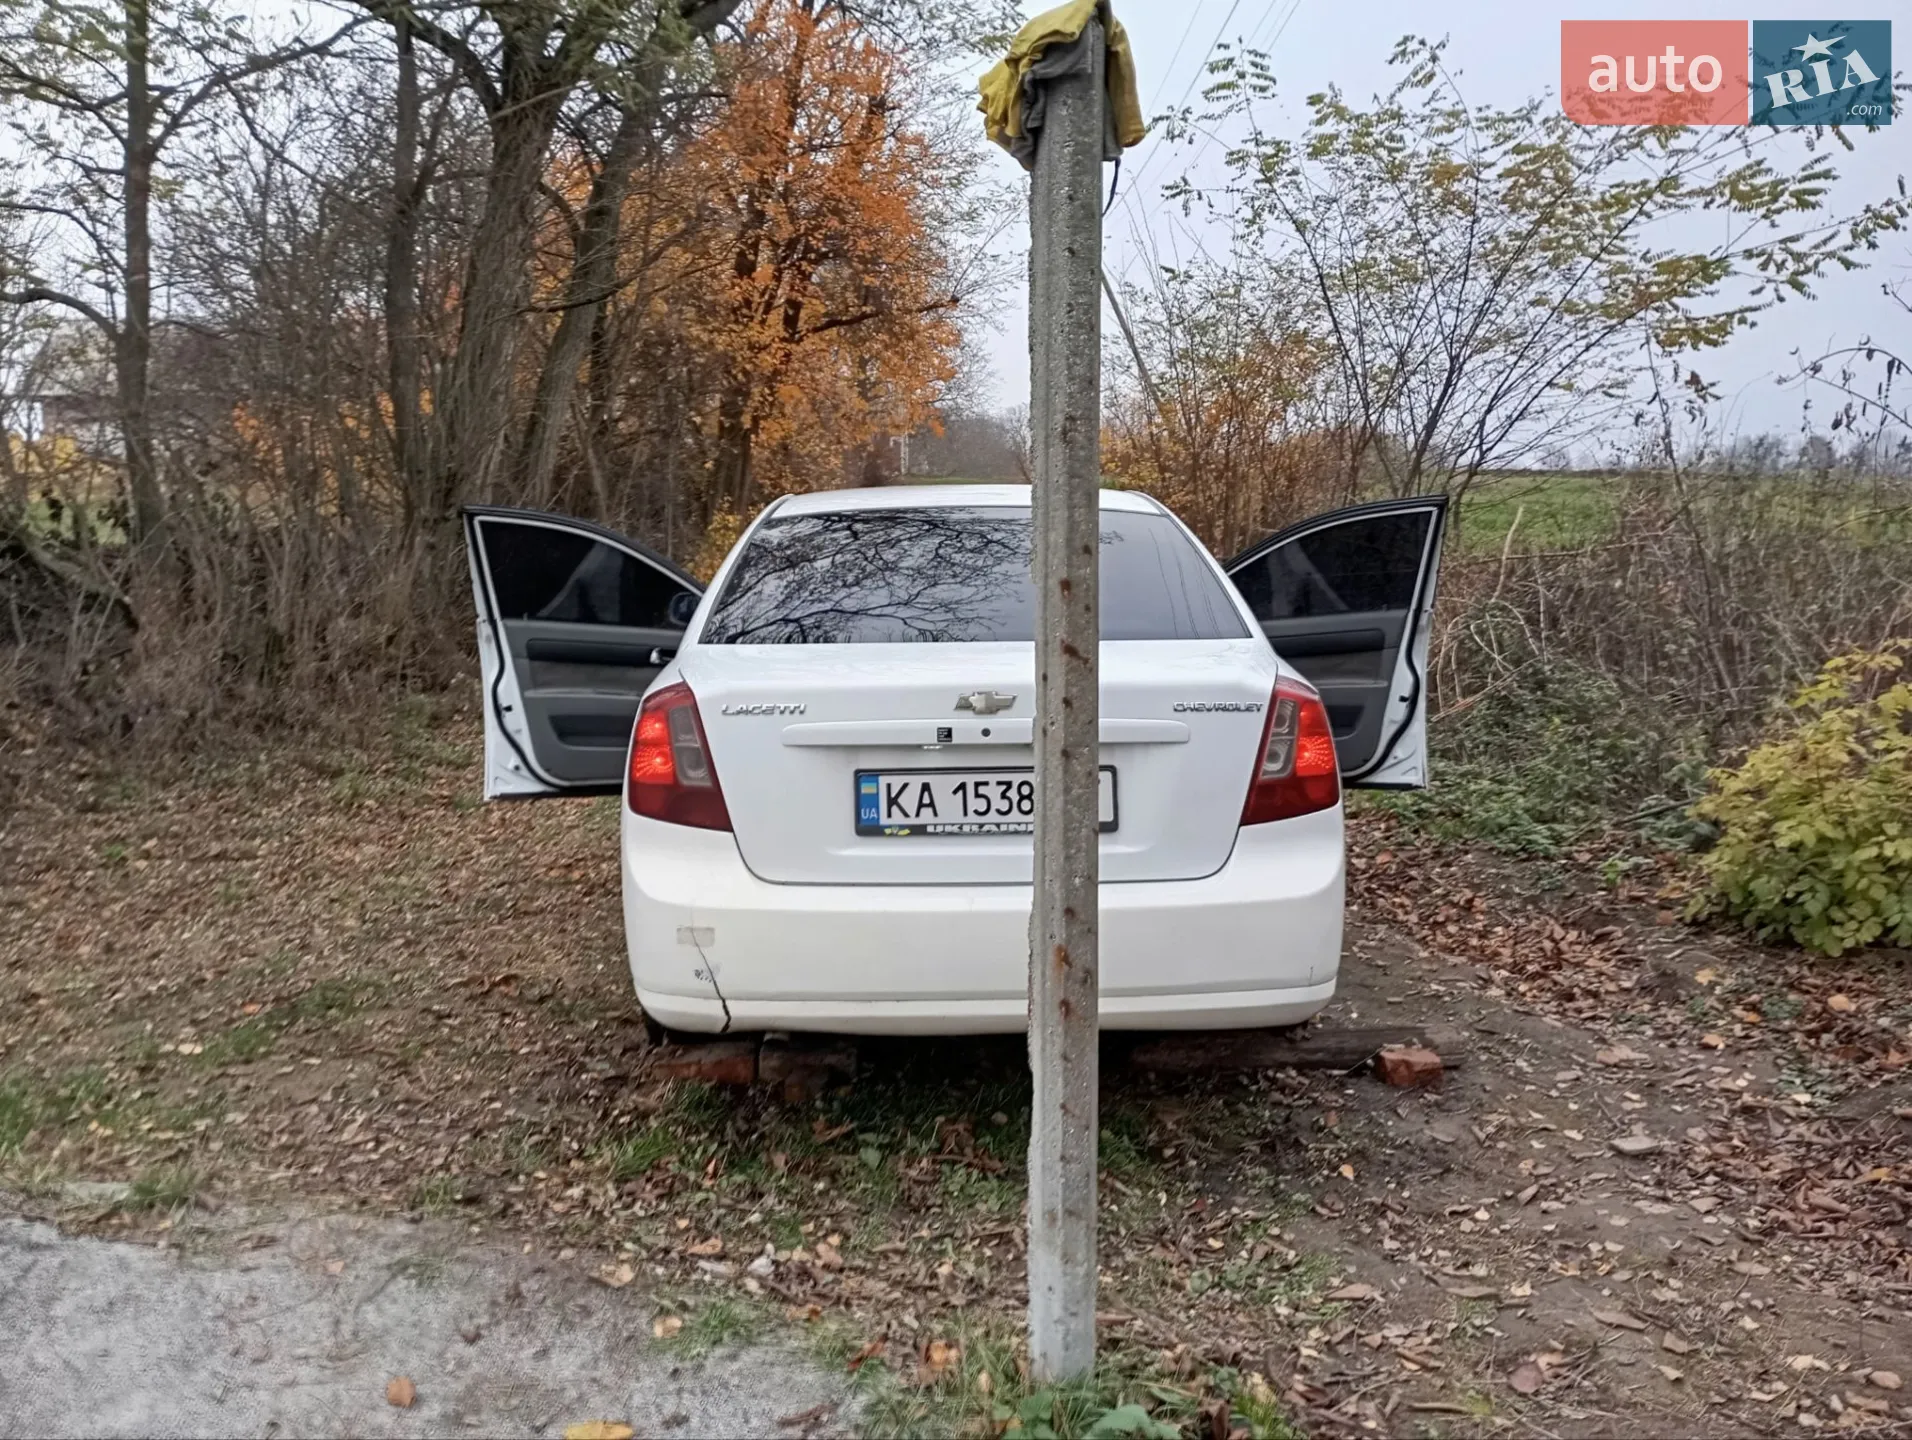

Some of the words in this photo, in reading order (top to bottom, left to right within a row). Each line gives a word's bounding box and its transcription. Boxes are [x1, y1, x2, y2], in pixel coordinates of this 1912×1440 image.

[722, 703, 807, 716] LACETTI
[1173, 701, 1263, 712] CHEVROLET
[886, 781, 938, 819] KA
[952, 780, 1034, 818] 1538
[861, 807, 878, 819] UA
